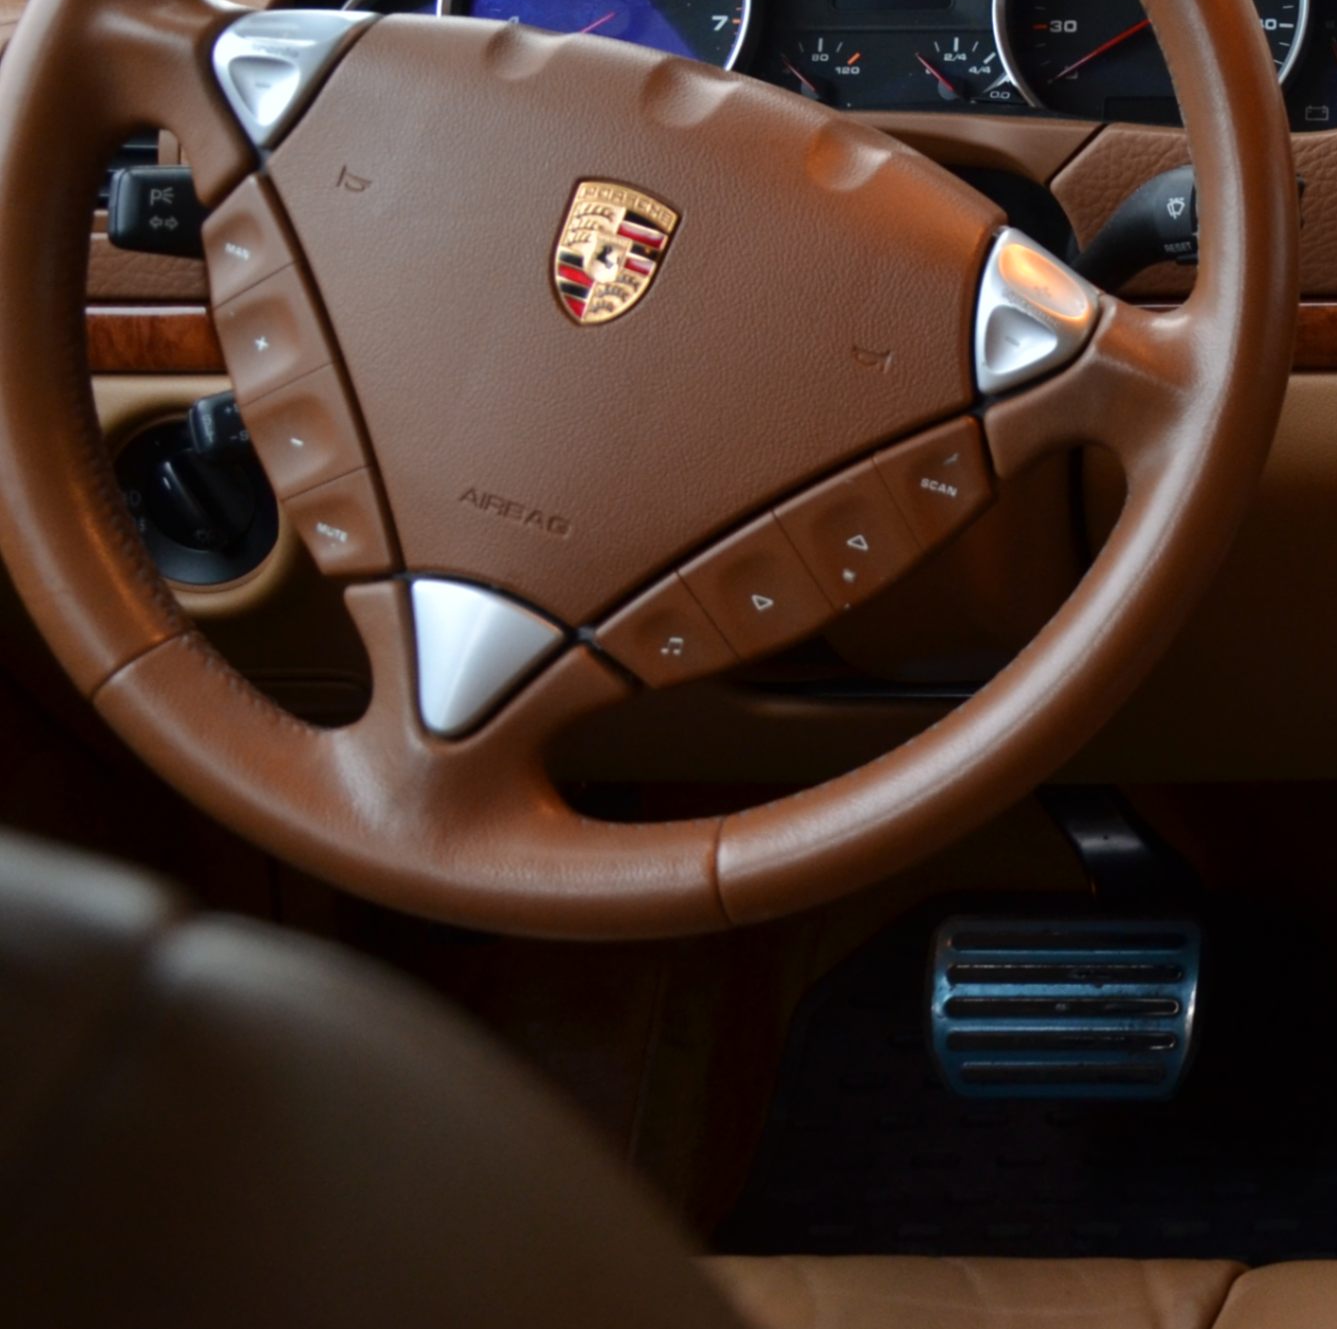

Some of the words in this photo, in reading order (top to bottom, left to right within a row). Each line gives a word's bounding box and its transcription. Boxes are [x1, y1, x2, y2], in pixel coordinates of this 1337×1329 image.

[711, 15, 730, 32] 7
[1048, 19, 1078, 33] 30
[811, 53, 830, 62] 80
[943, 53, 968, 62] 2/4
[834, 66, 861, 75] 120
[968, 65, 992, 75] 4/4
[578, 186, 678, 235] PORSCHE
[920, 477, 958, 498] SCAN
[457, 486, 572, 537] AIRBAG
[316, 521, 348, 543] MUTE
